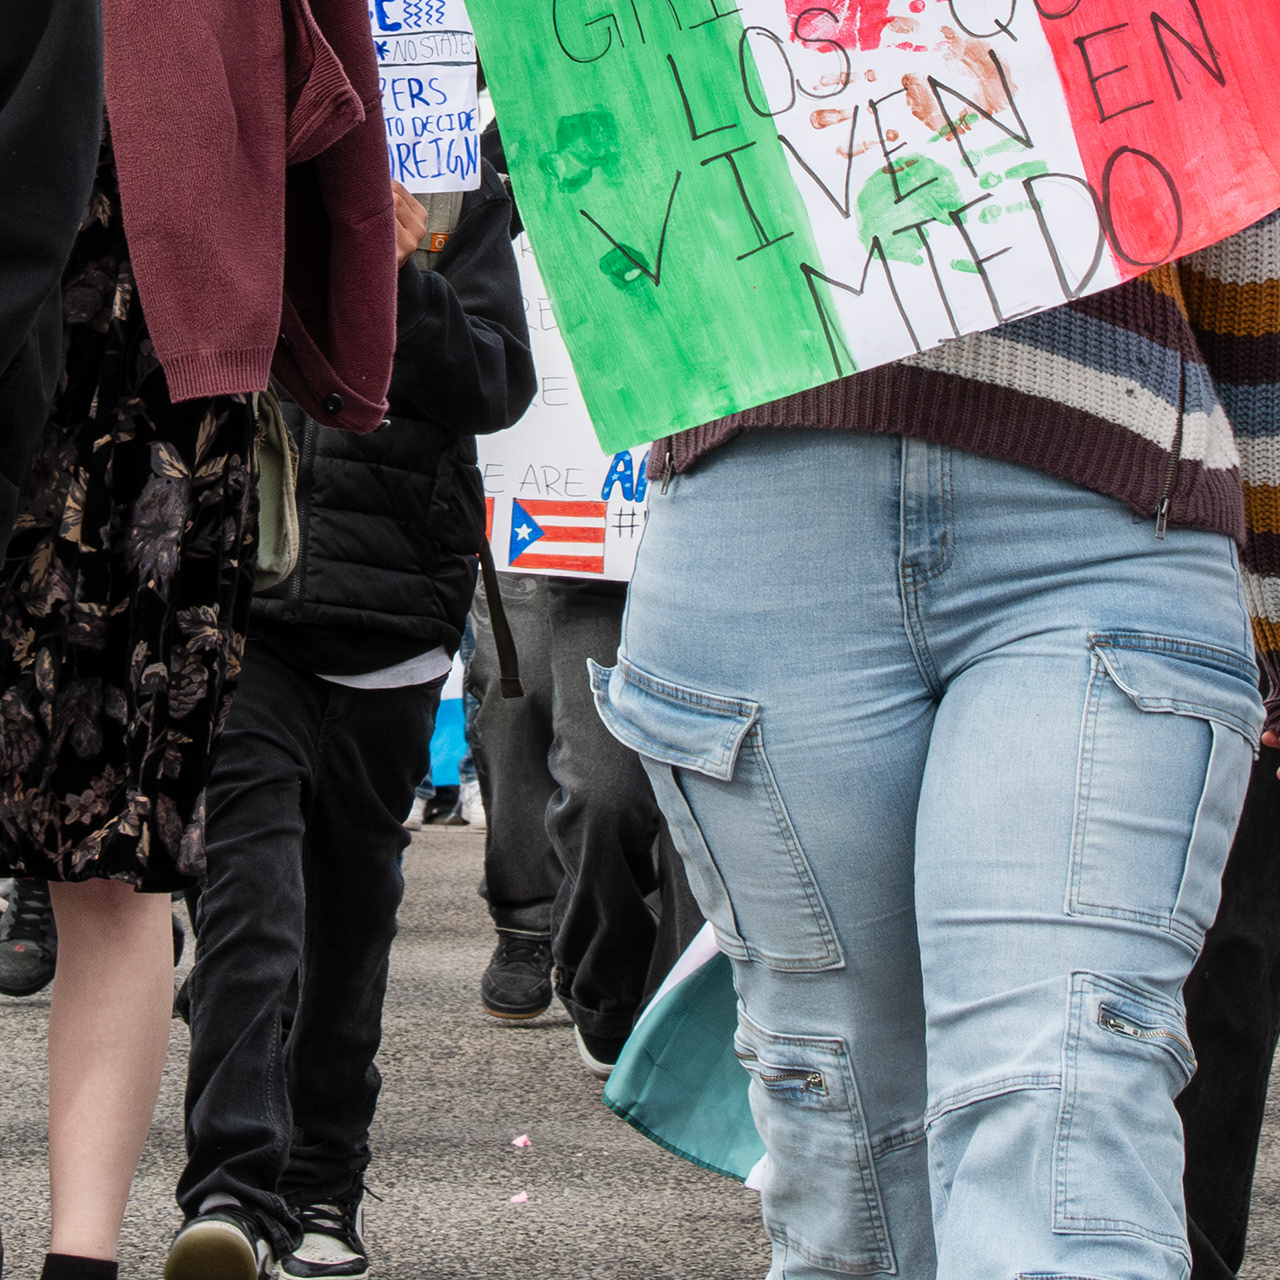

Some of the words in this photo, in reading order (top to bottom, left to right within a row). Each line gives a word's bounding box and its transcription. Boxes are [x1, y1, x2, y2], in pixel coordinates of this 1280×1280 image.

[667, 6, 851, 143] LOS
[580, 49, 1034, 287] VIVEN
[801, 145, 1184, 378] MIEDO
[518, 463, 587, 498] ARE
